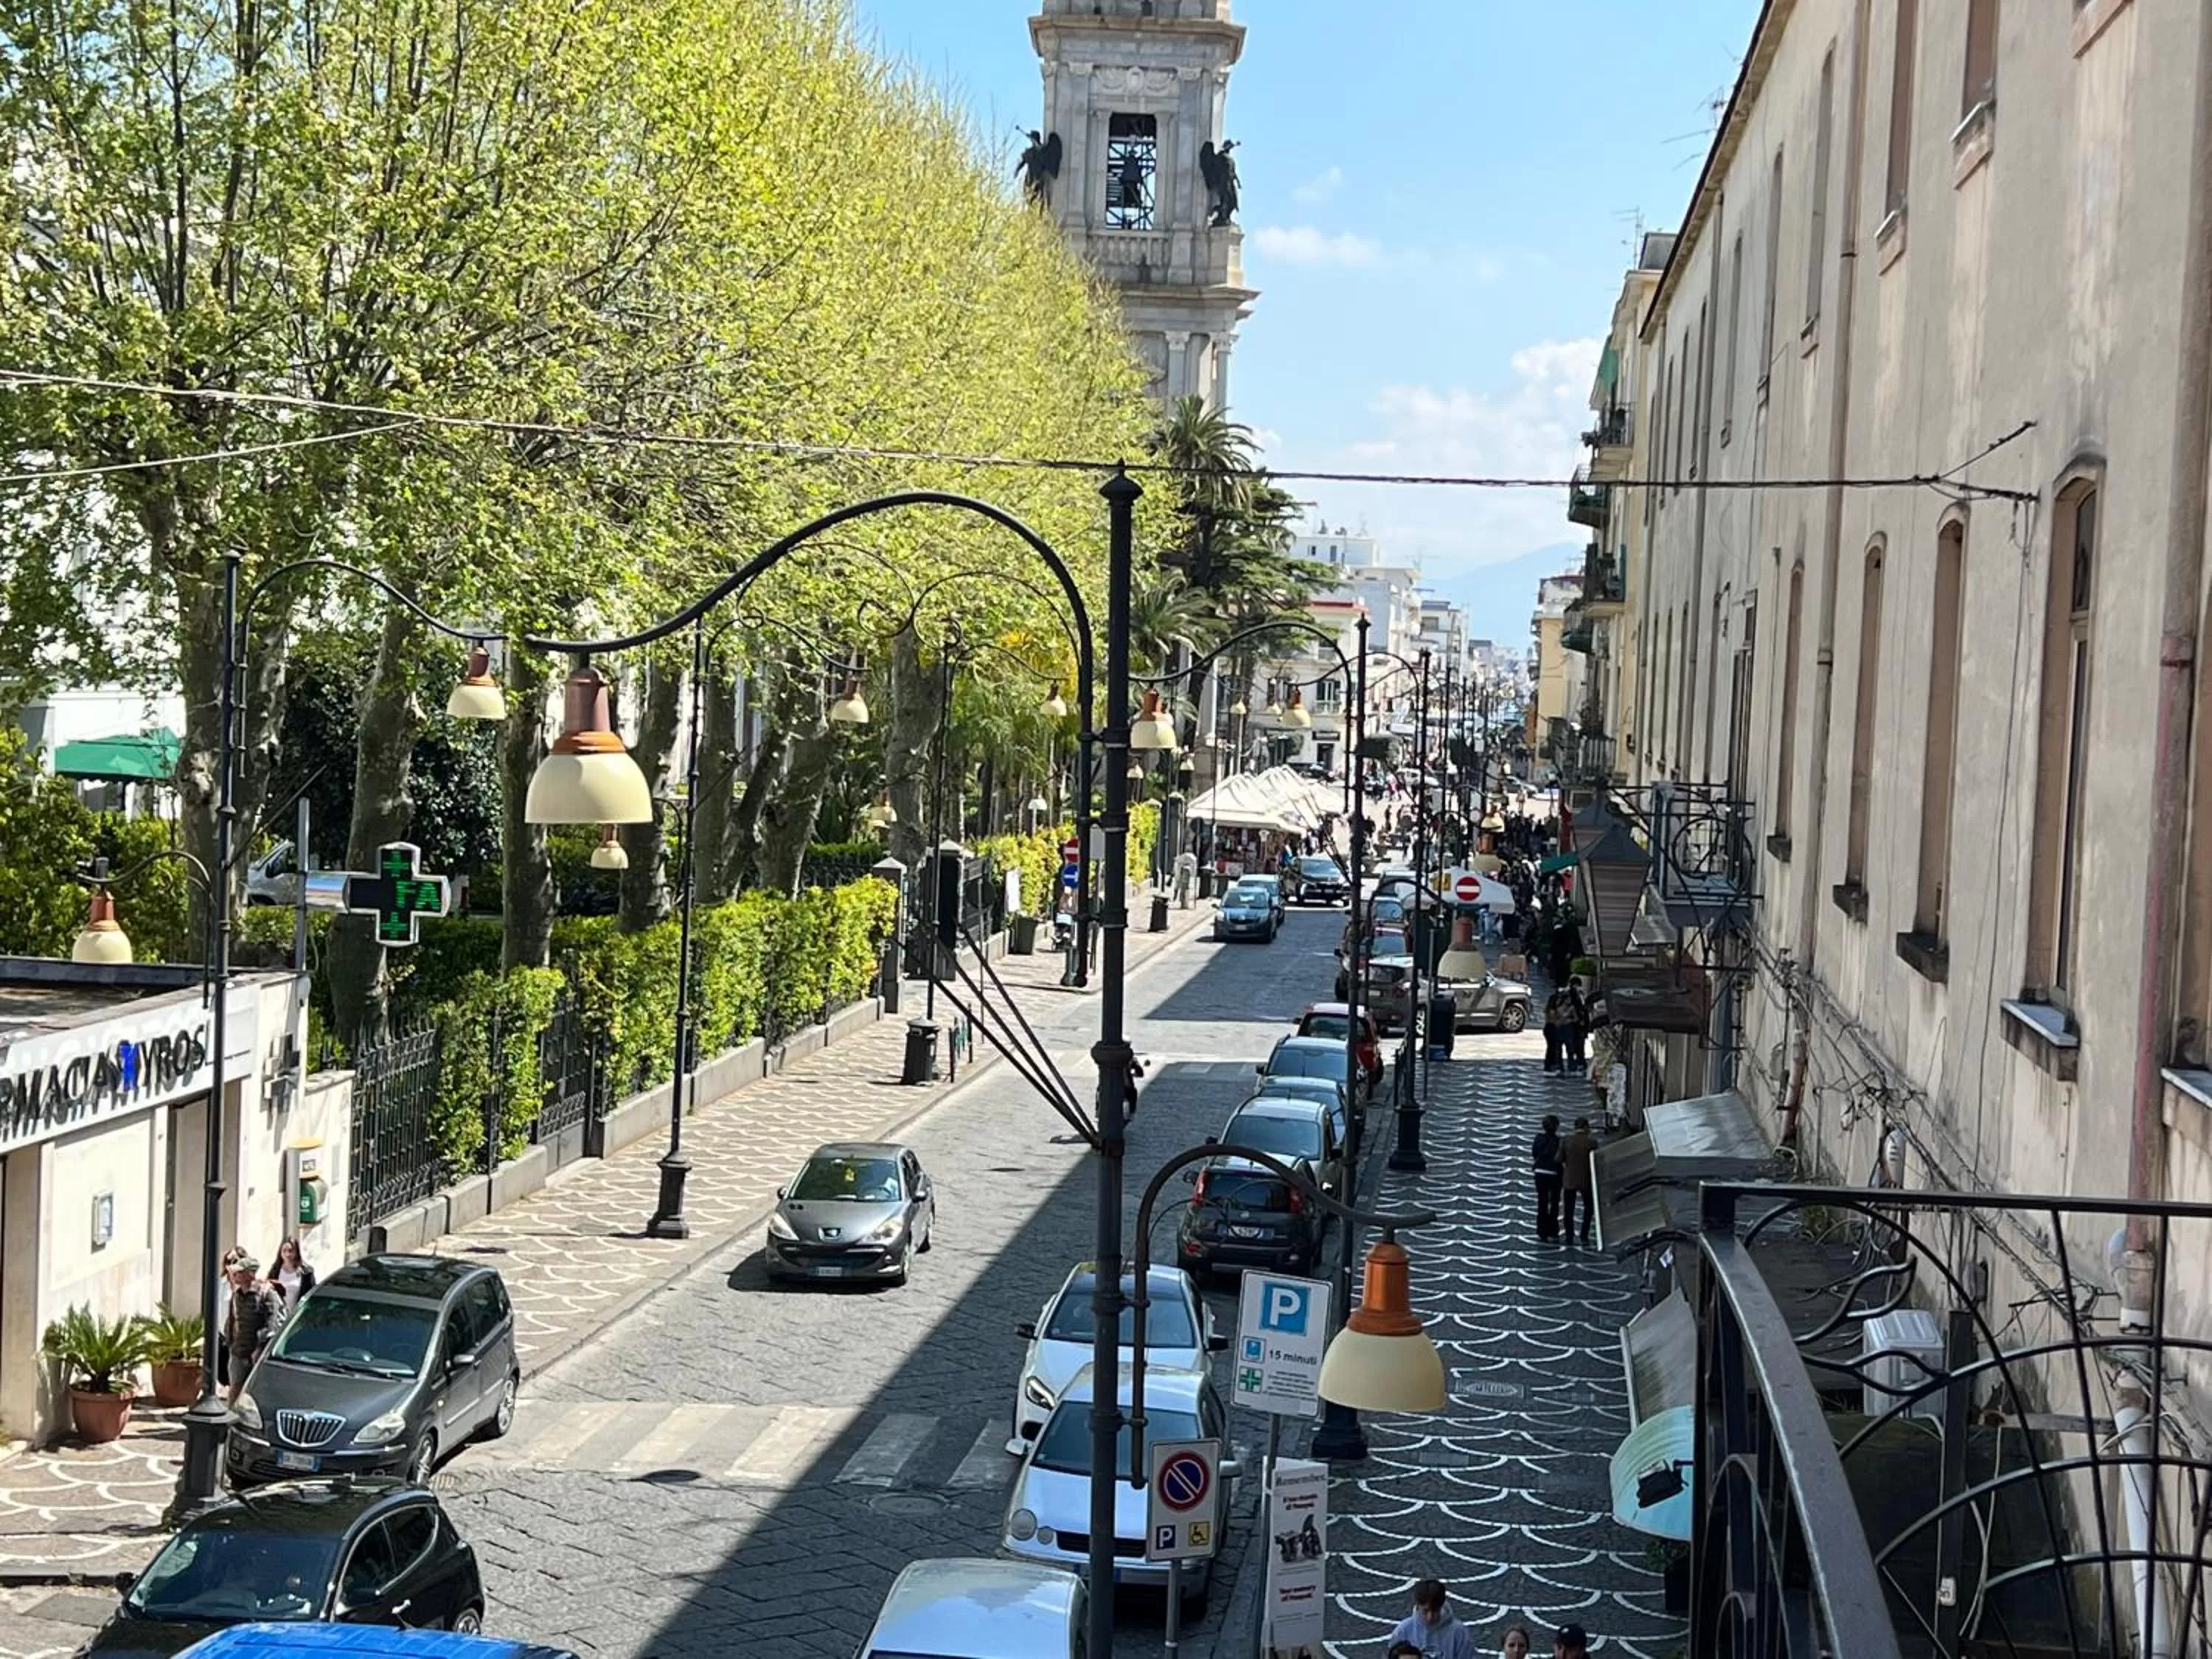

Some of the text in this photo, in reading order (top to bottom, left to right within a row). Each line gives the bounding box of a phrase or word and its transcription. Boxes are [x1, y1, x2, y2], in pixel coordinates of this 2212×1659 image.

[1270, 1287, 1301, 1326] P
[1269, 1349, 1318, 1366] 15 minuti
[1159, 1527, 1173, 1548] P
